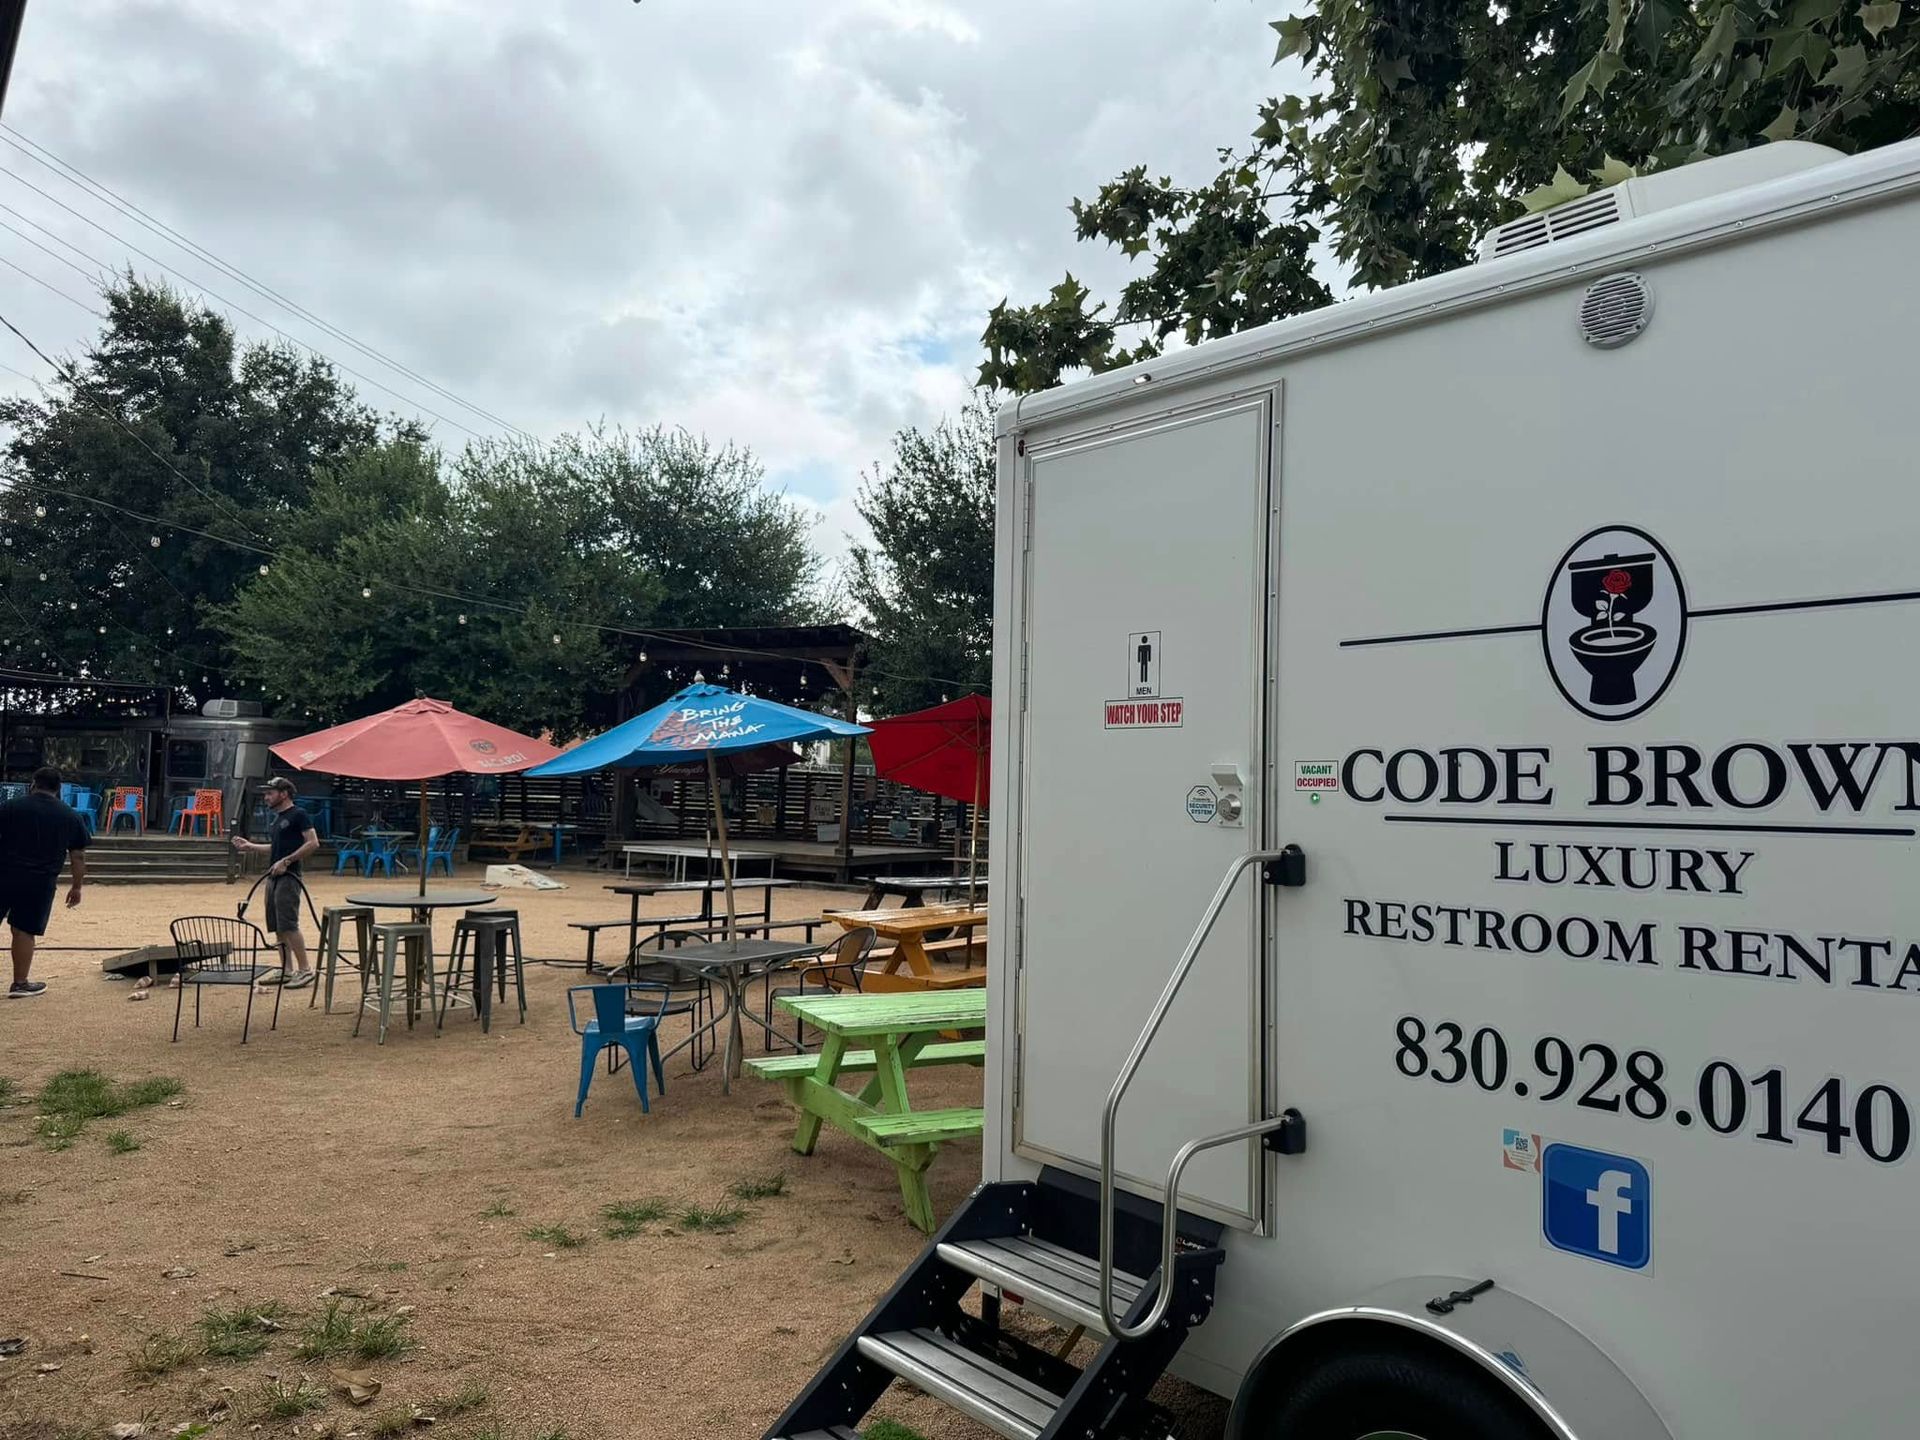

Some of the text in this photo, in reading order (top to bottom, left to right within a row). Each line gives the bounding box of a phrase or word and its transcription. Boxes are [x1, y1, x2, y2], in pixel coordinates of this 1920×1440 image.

[1136, 687, 1152, 695] MEN
[677, 701, 748, 721] BRING
[1107, 702, 1181, 724] WATCH YOUR STEP
[700, 715, 743, 730] THE
[1301, 765, 1333, 775] VACANT
[1341, 747, 1554, 805] CODE
[1297, 777, 1337, 787] OCCUPIED
[1494, 842, 1755, 895] LUXURY
[1343, 899, 1659, 966] RESTROOM
[1395, 1016, 1911, 1163] 830.928.0140
